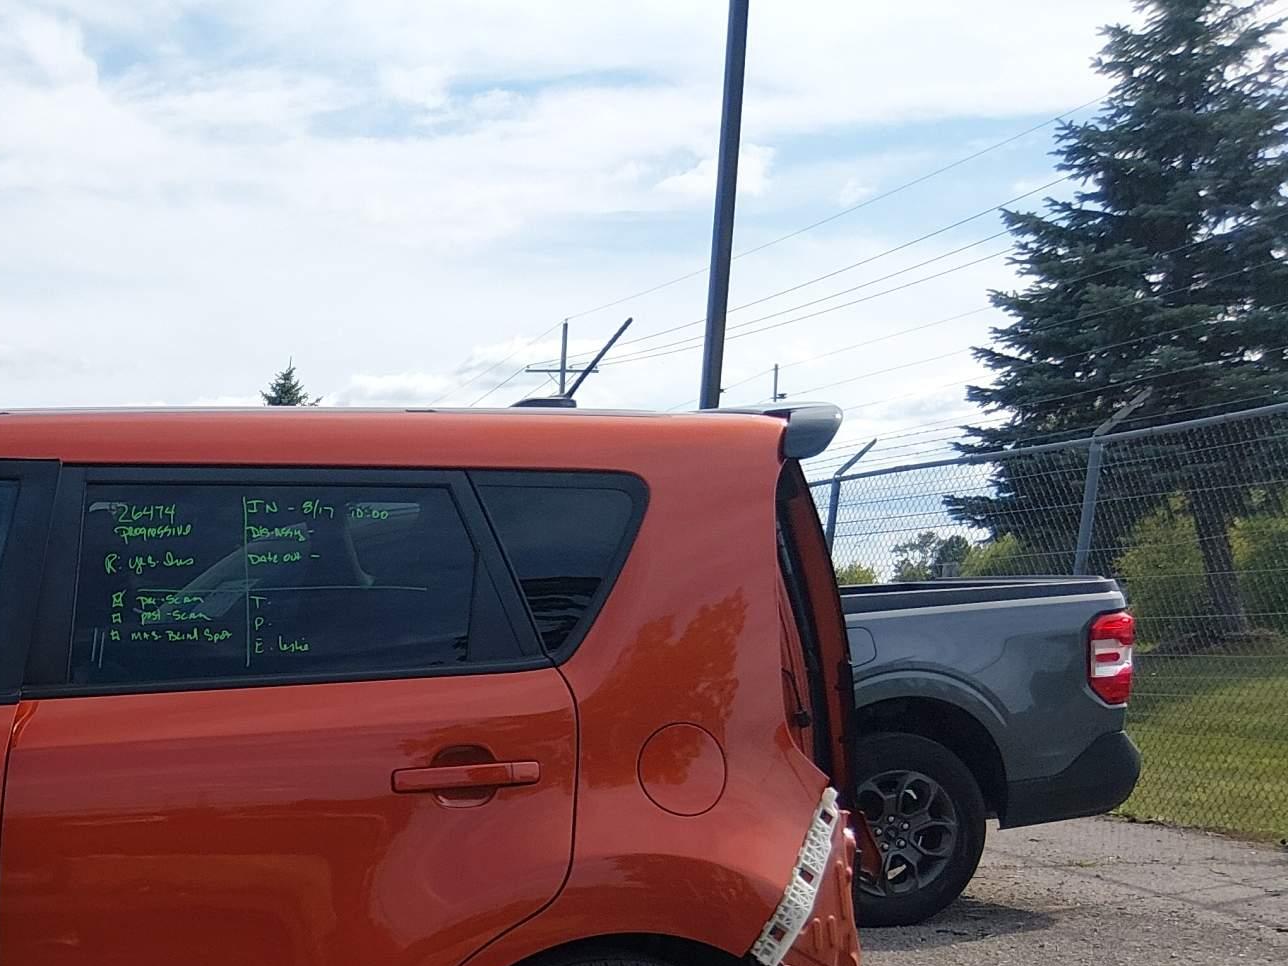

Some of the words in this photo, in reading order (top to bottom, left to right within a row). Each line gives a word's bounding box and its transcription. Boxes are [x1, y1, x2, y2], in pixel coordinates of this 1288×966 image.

[117, 503, 176, 525] 26474
[247, 500, 278, 513] IN
[302, 499, 334, 519] 8/17
